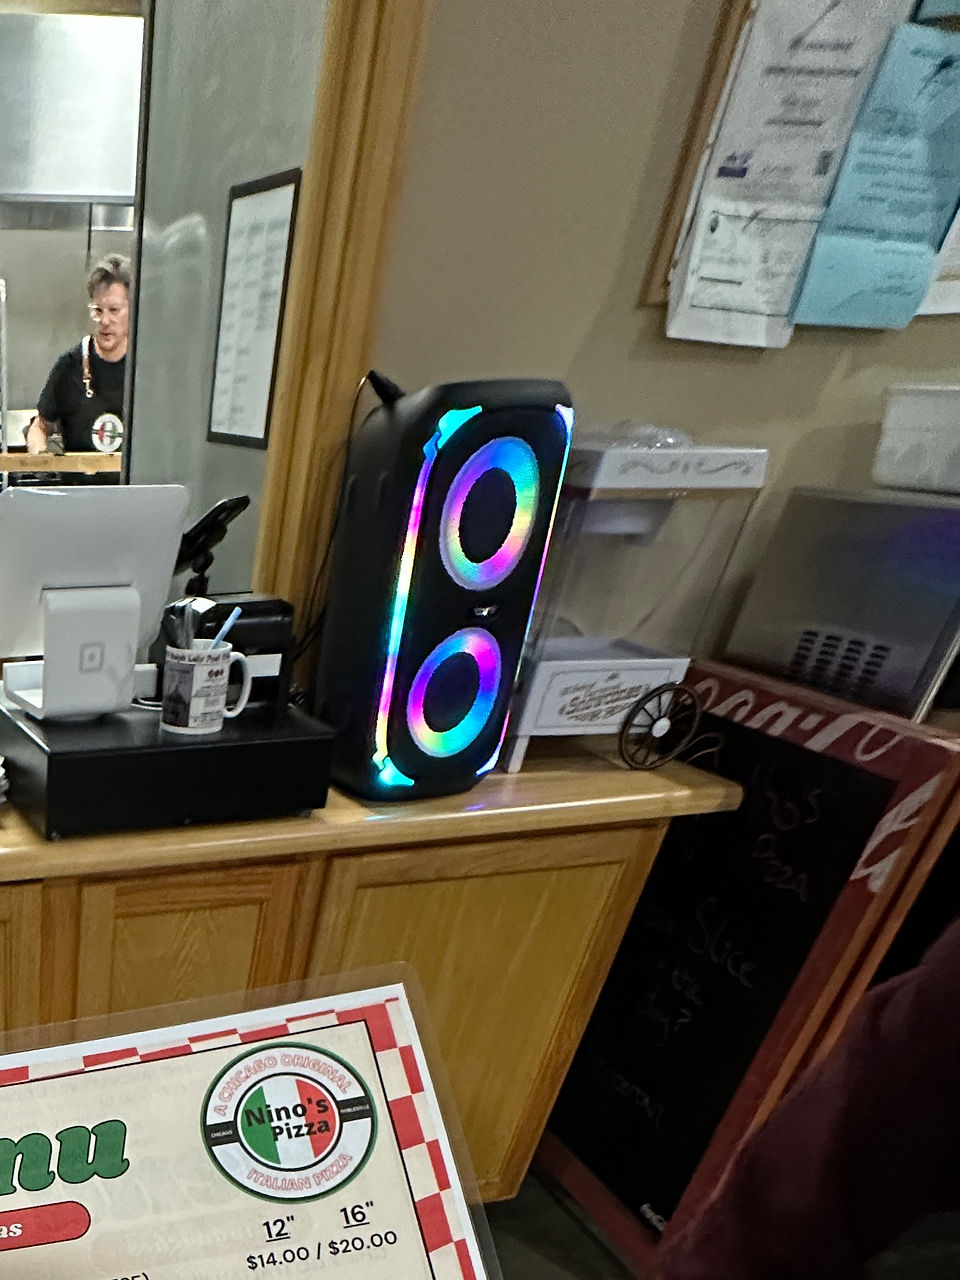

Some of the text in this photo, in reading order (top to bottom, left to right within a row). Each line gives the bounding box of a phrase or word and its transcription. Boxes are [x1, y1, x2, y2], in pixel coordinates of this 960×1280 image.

[688, 895, 761, 989] Slice
[214, 1053, 352, 1117] A CHICAGO ORIGINAL
[243, 1097, 329, 1127] Nino's
[273, 1119, 330, 1141] Pizza
[247, 1153, 353, 1191] ITALIAN PIZZA
[263, 1201, 374, 1241] 12" 16"
[246, 1230, 398, 1272] $14.00 / $20.00
